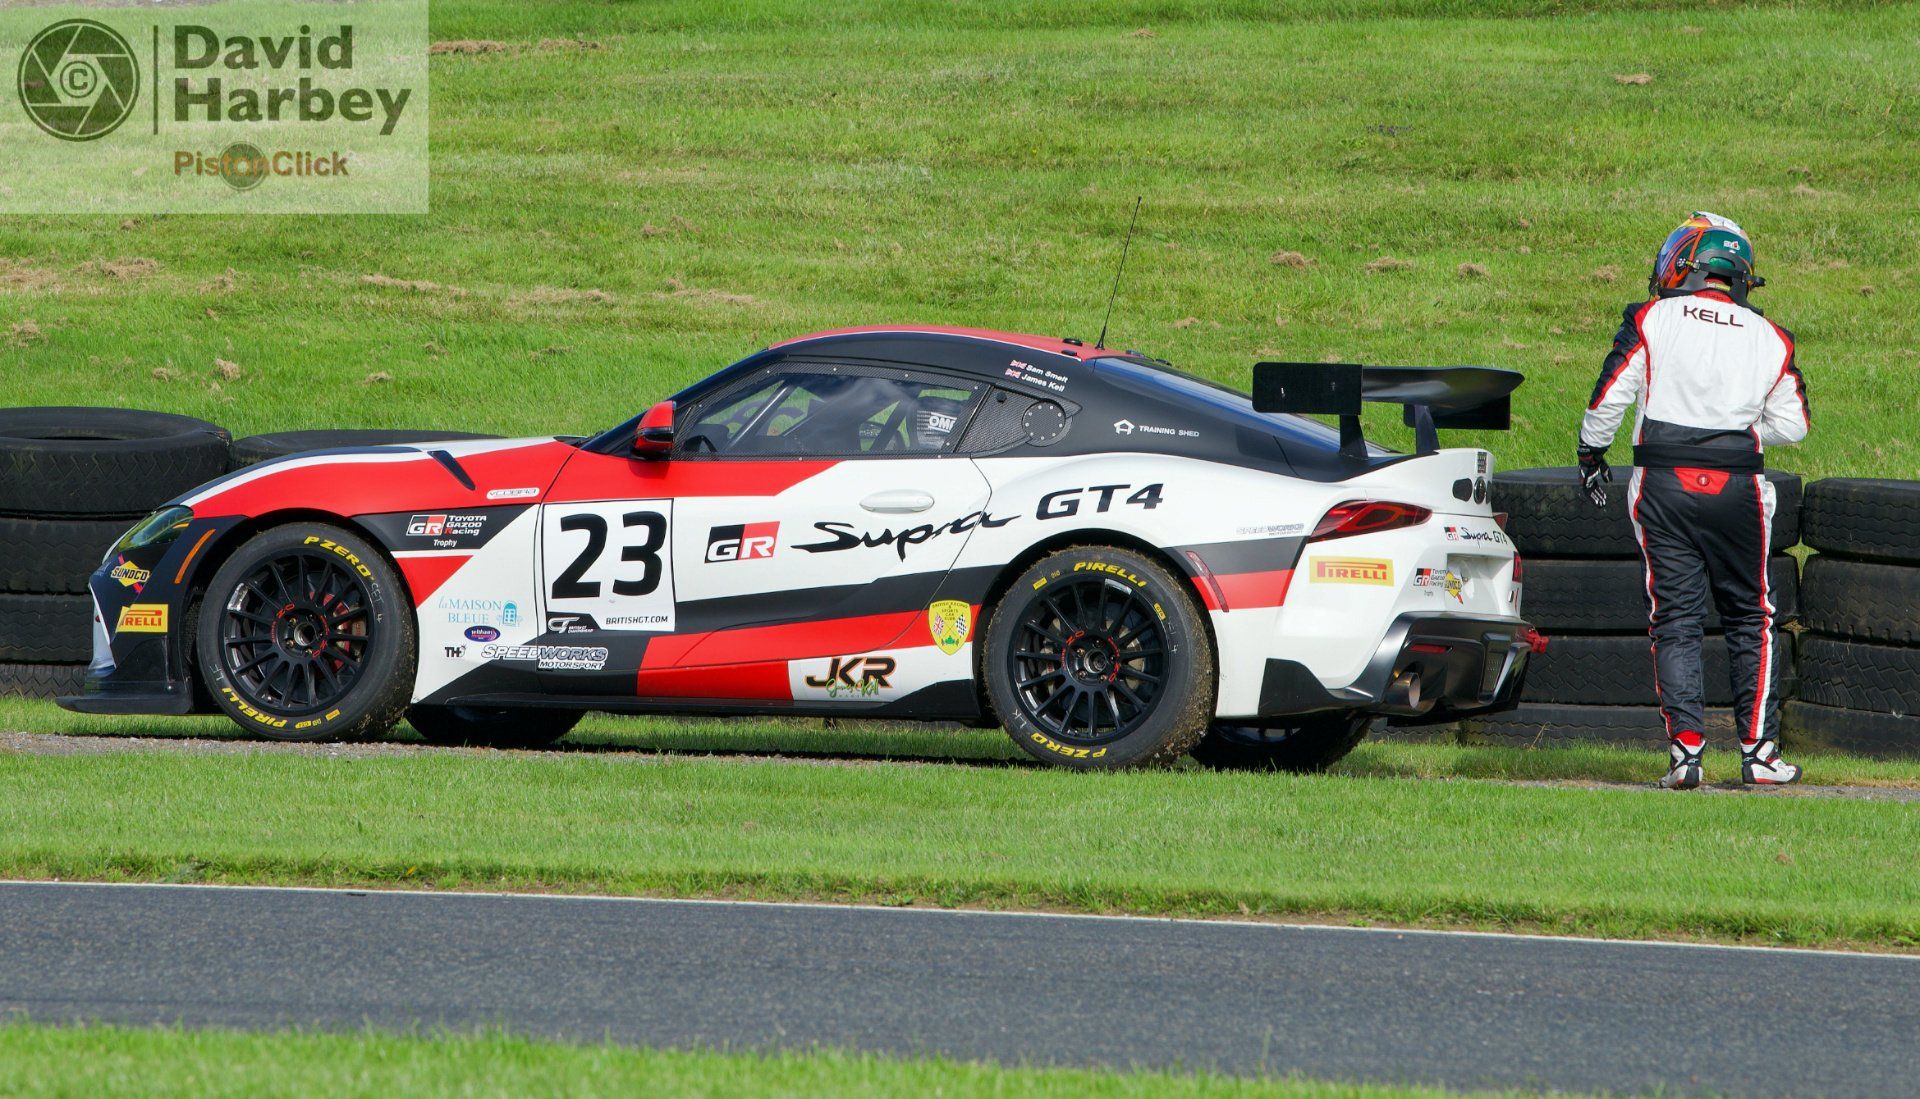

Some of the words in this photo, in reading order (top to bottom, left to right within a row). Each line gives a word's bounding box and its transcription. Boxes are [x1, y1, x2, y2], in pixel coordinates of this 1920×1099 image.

[1683, 304, 1745, 328] KELL
[1026, 364, 1043, 376] Sam
[1021, 373, 1047, 387] James
[1049, 380, 1065, 392] Kell
[1139, 425, 1176, 435] TRAINING
[1178, 429, 1200, 437] SHED
[1036, 483, 1164, 521] GT4
[408, 522, 442, 535] GR
[444, 527, 480, 536] Racing
[790, 510, 1022, 562] Supra
[433, 539, 458, 548] Trophy
[706, 537, 775, 562] GR
[551, 510, 668, 600] 23
[111, 567, 149, 581] SUNOCO
[1073, 561, 1147, 588] PIRELLI
[1316, 561, 1388, 581] PIRELLI
[449, 598, 502, 611] MAISON
[448, 612, 490, 624] BLEUE
[605, 615, 669, 625] BRITISHGT.COM
[481, 643, 608, 662] SPEEDWORKS
[538, 660, 606, 670] MOTORSPORT
[804, 656, 896, 688] JKR
[222, 687, 288, 728] PIRELLI
